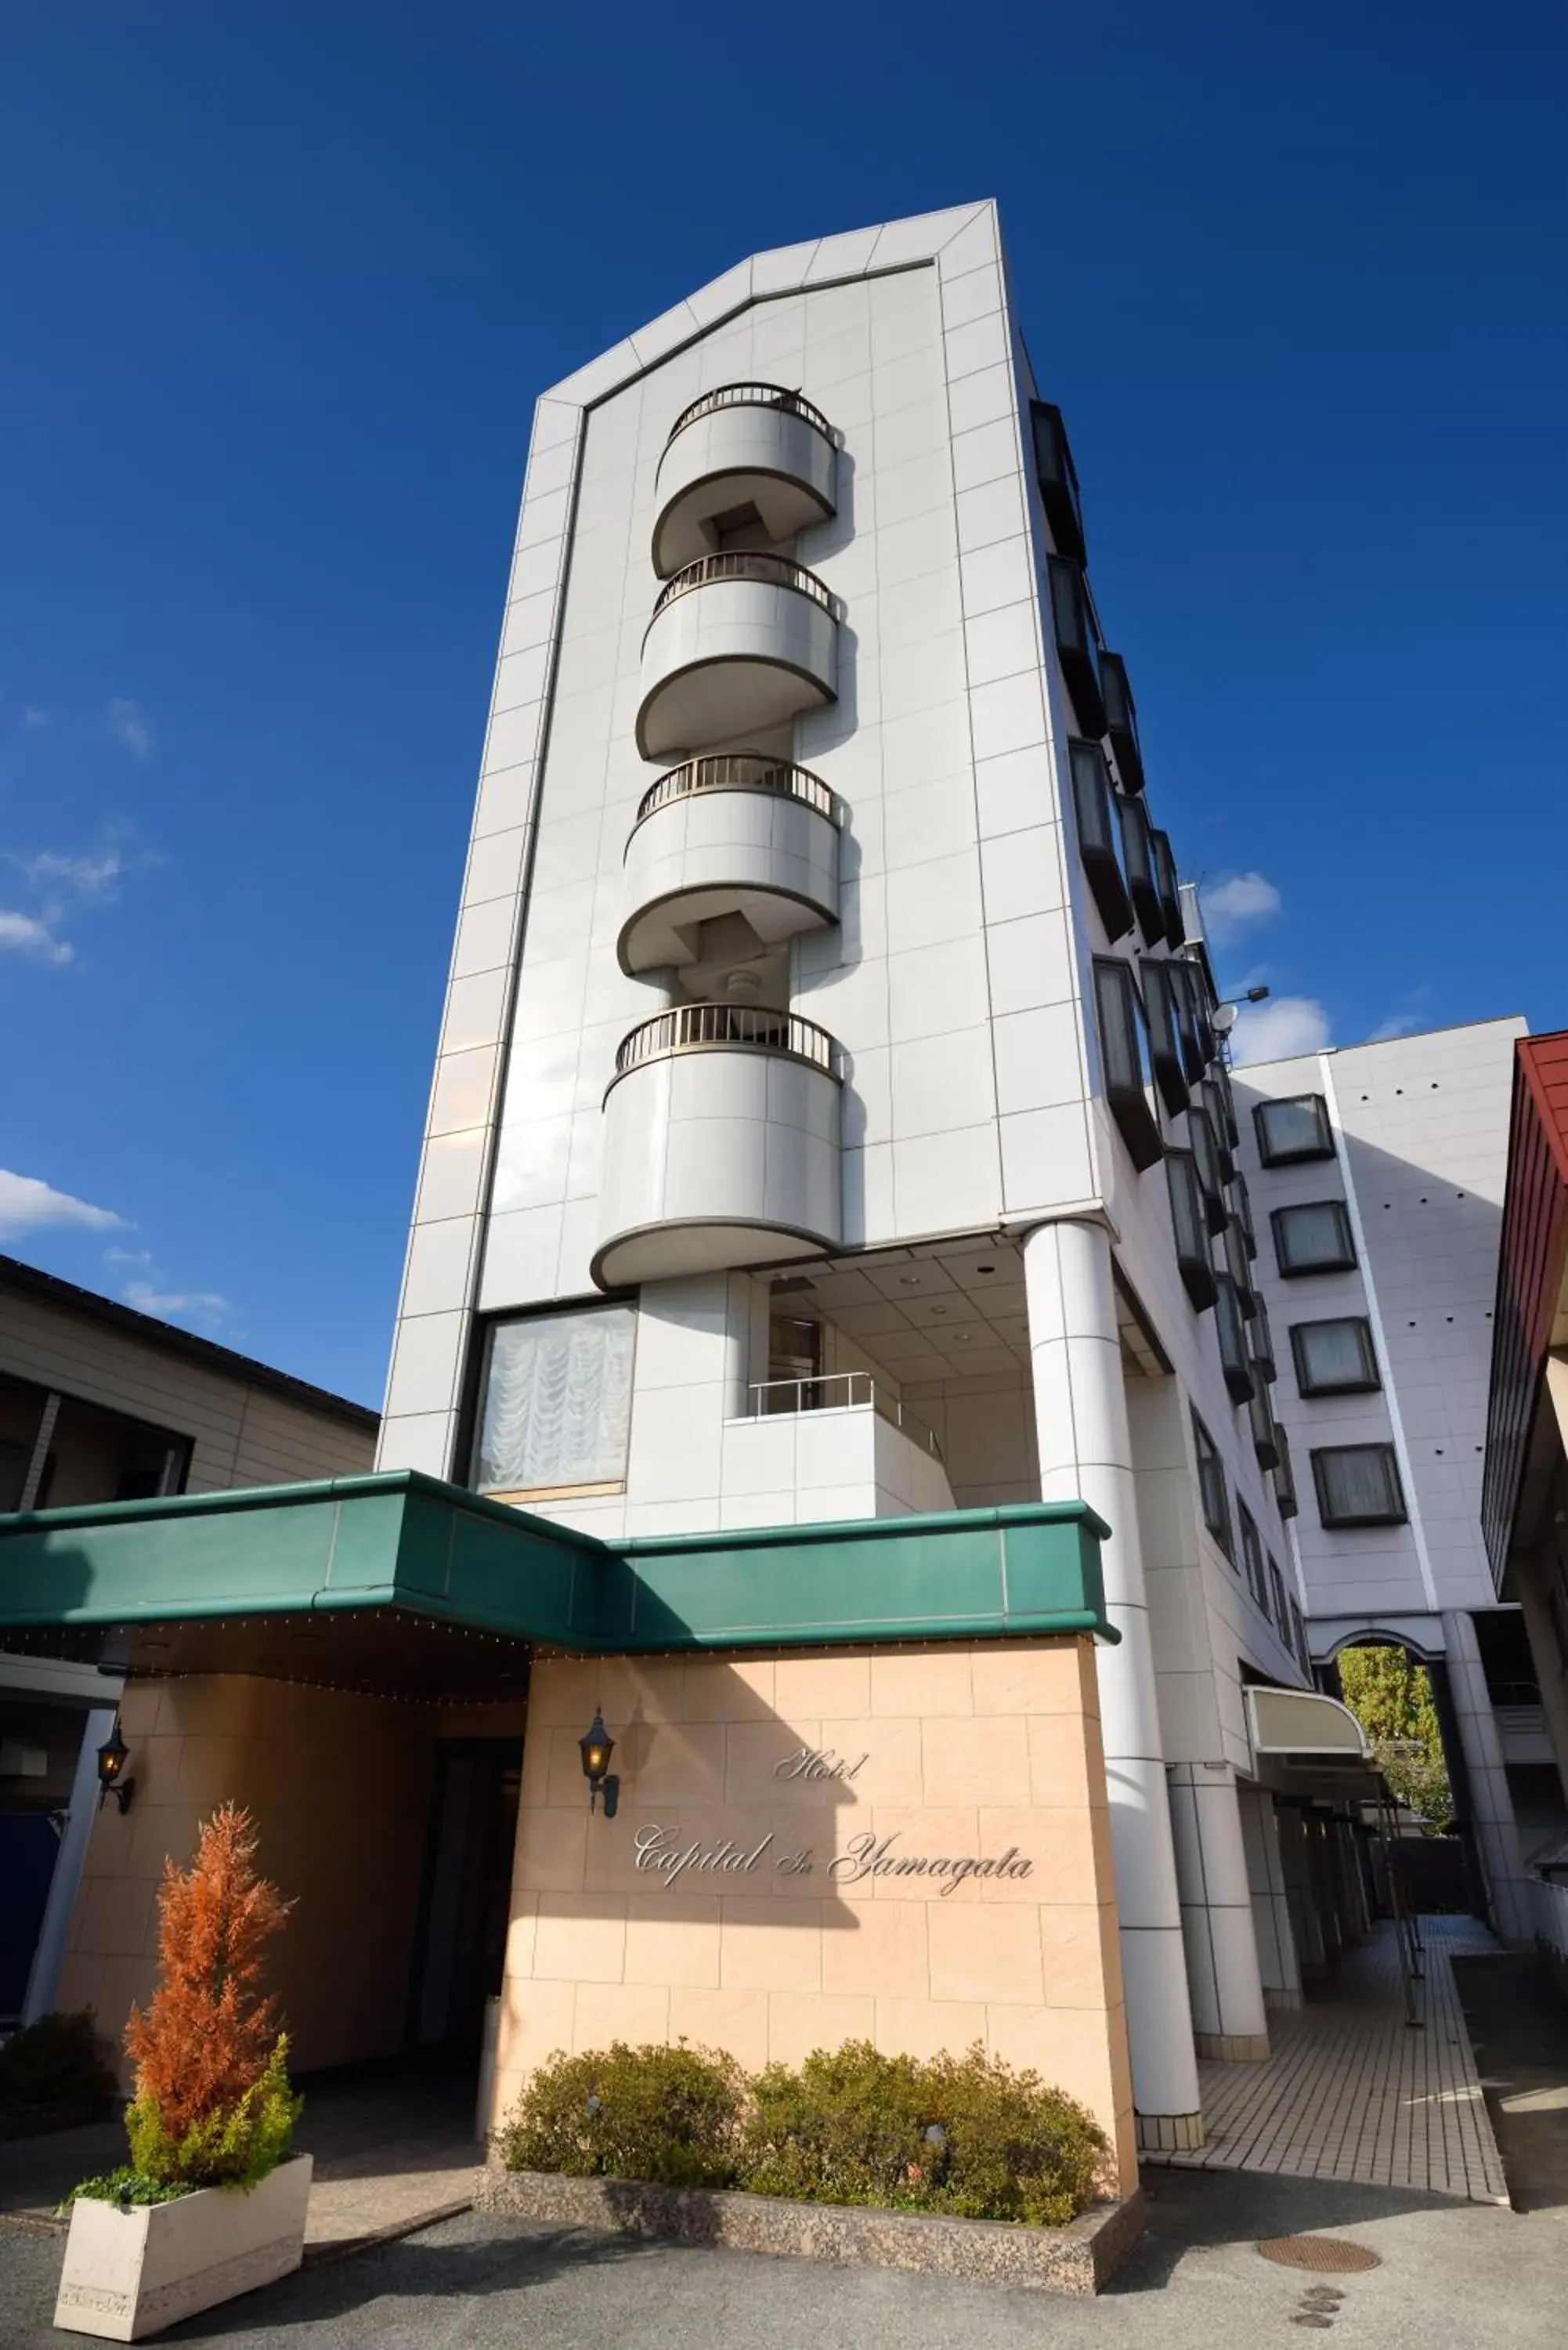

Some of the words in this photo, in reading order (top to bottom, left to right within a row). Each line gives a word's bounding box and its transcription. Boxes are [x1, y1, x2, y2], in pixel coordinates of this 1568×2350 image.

[772, 1747, 869, 1781] Hotel
[634, 1824, 774, 1888] Capital
[826, 1831, 1035, 1897] Yamagata
